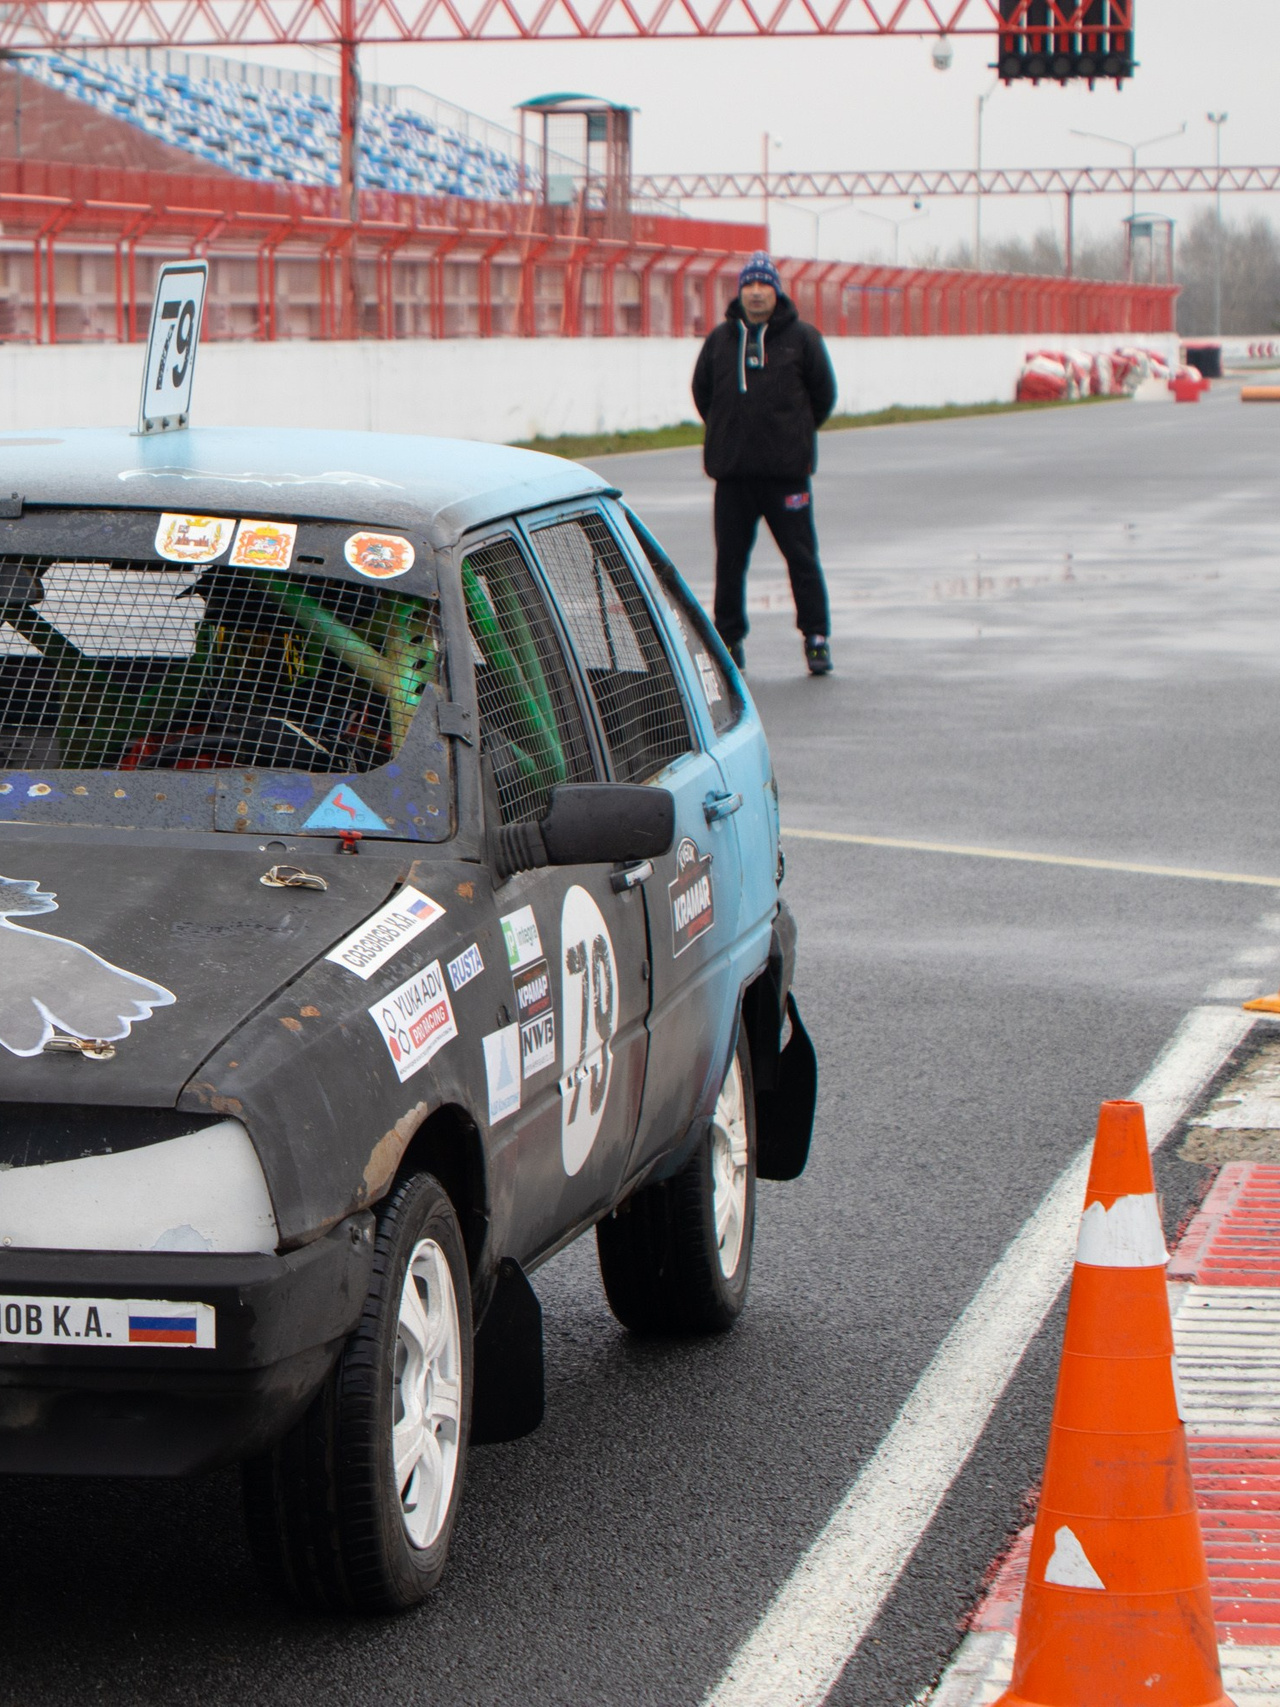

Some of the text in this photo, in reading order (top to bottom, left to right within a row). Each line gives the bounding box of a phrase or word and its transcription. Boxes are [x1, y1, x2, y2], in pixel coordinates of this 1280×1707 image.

[155, 299, 196, 391] 79
[673, 875, 711, 932] KRAMAR
[341, 924, 401, 968] САЗОНОВ
[450, 946, 483, 988] RUSTA
[393, 967, 442, 1021] YUKA ADV
[522, 1016, 554, 1057] NWB
[53, 1304, 113, 1339] К.А.
